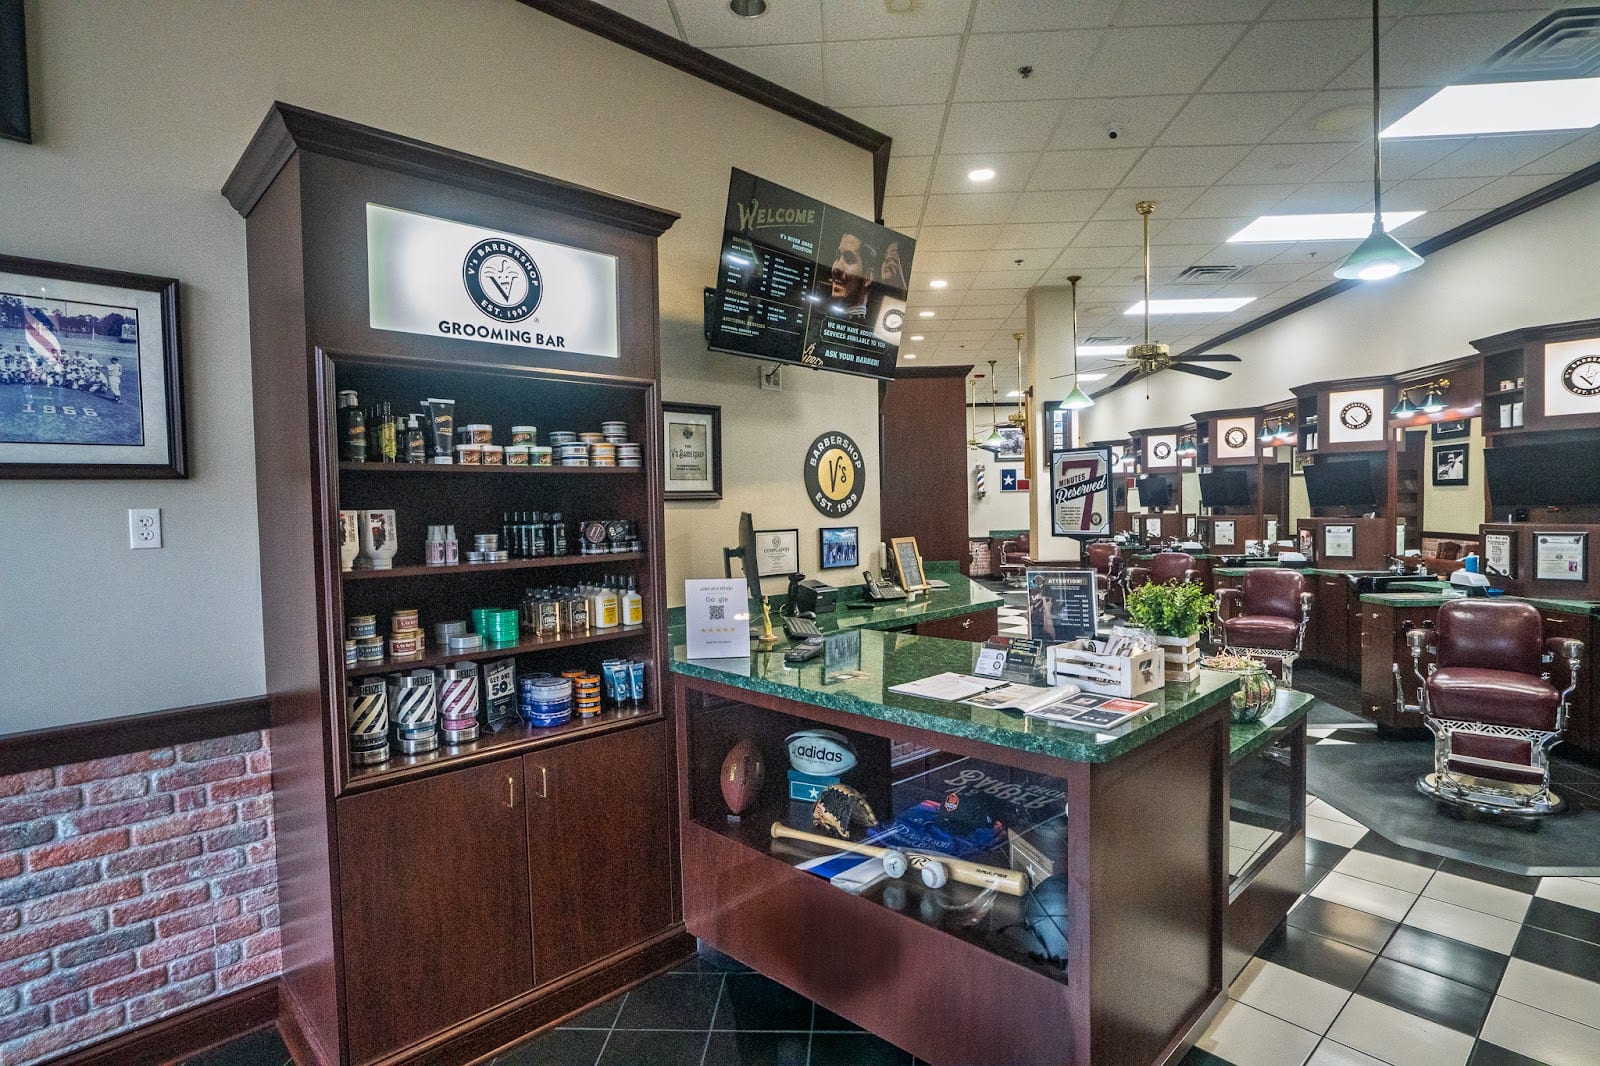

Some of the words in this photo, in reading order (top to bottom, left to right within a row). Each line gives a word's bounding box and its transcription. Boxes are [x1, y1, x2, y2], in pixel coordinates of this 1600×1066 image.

[737, 199, 816, 231] WELCOME
[477, 243, 539, 287] BARBERSHOP
[481, 299, 503, 318] EST.
[507, 305, 528, 318] 1999
[438, 320, 532, 344] GROOMING
[536, 333, 565, 348] BAR
[824, 349, 838, 359] ASK
[839, 351, 855, 362] YOUR
[809, 436, 862, 469] BARBERSHOP
[829, 455, 847, 493] V's
[1058, 473, 1086, 487] MINUTES
[815, 492, 833, 512] EST.
[836, 493, 858, 513] 1999
[1055, 474, 1106, 504] Reserved
[1061, 459, 1099, 531] 7
[797, 745, 843, 763] adidas
